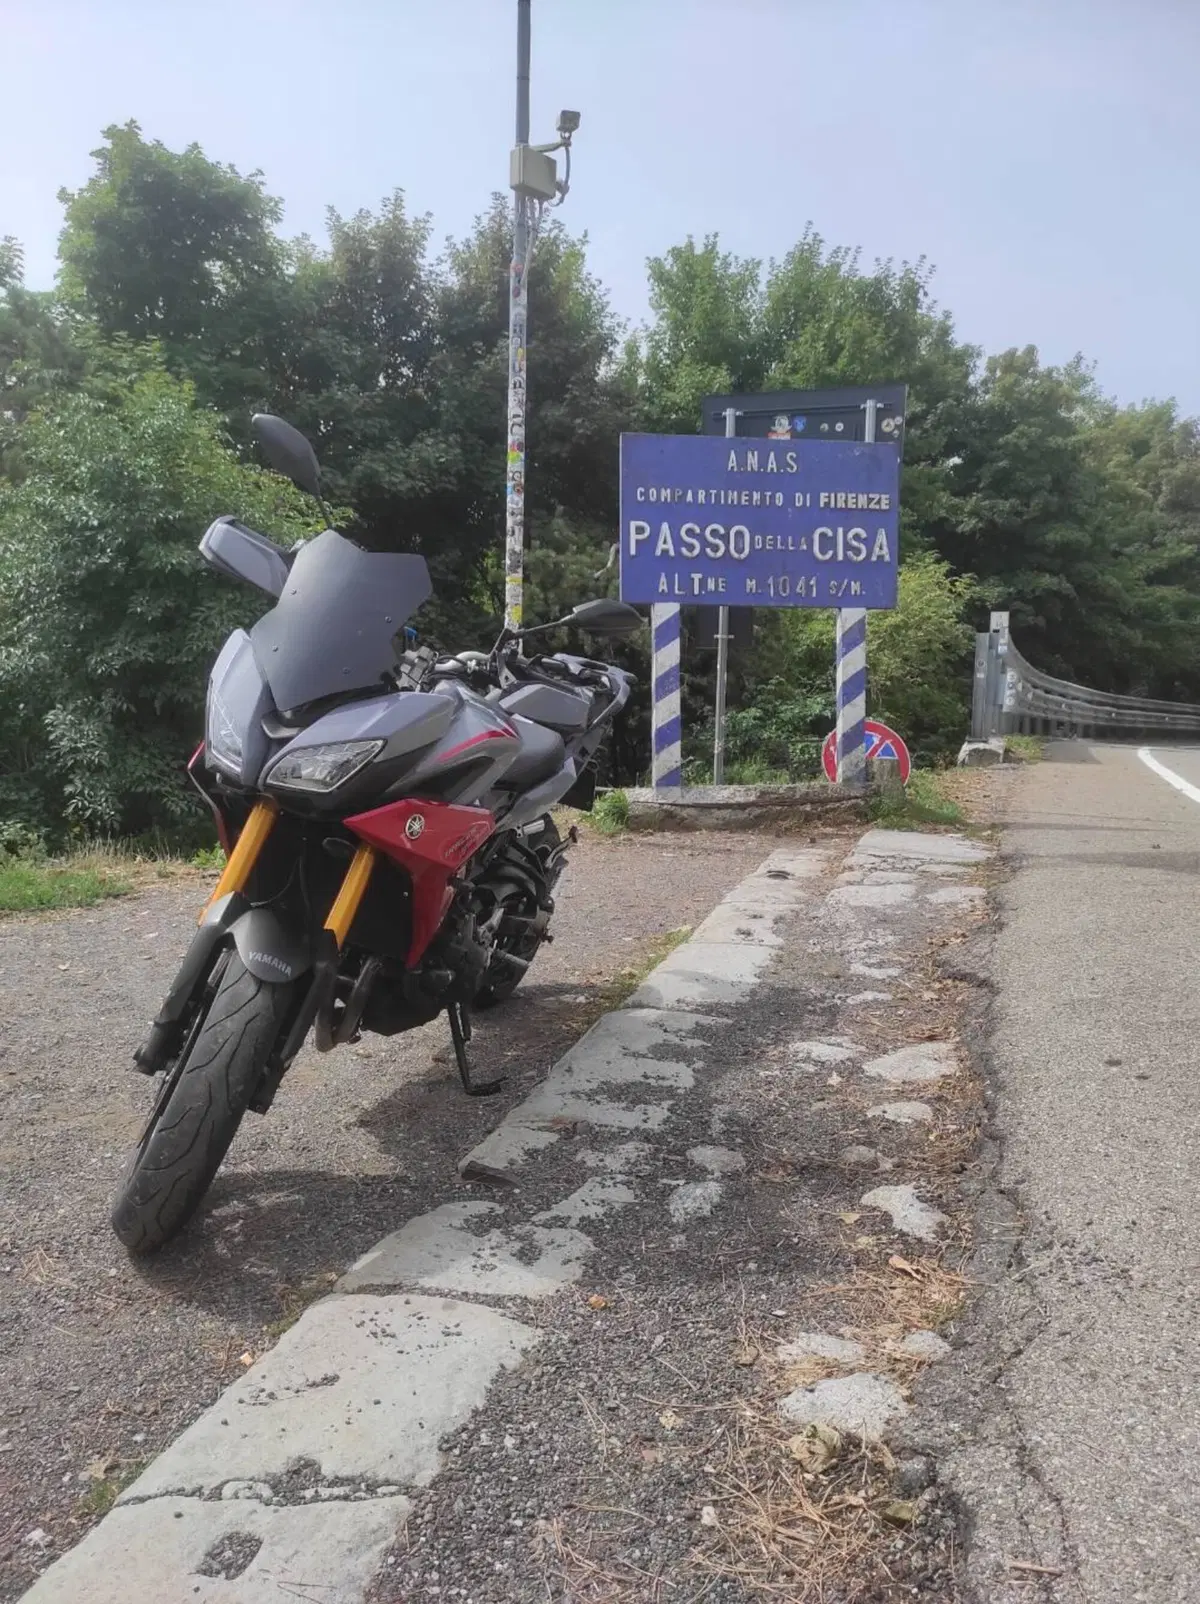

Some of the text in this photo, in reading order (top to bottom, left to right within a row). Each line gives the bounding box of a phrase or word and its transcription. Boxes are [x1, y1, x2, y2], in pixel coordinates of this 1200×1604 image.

[636, 486, 891, 510] COMPARTIMENTO DI FIRENZE
[629, 520, 891, 562] PASSO DELLA CISA
[767, 575, 817, 598] 1041
[248, 951, 292, 977] YAMAHA
